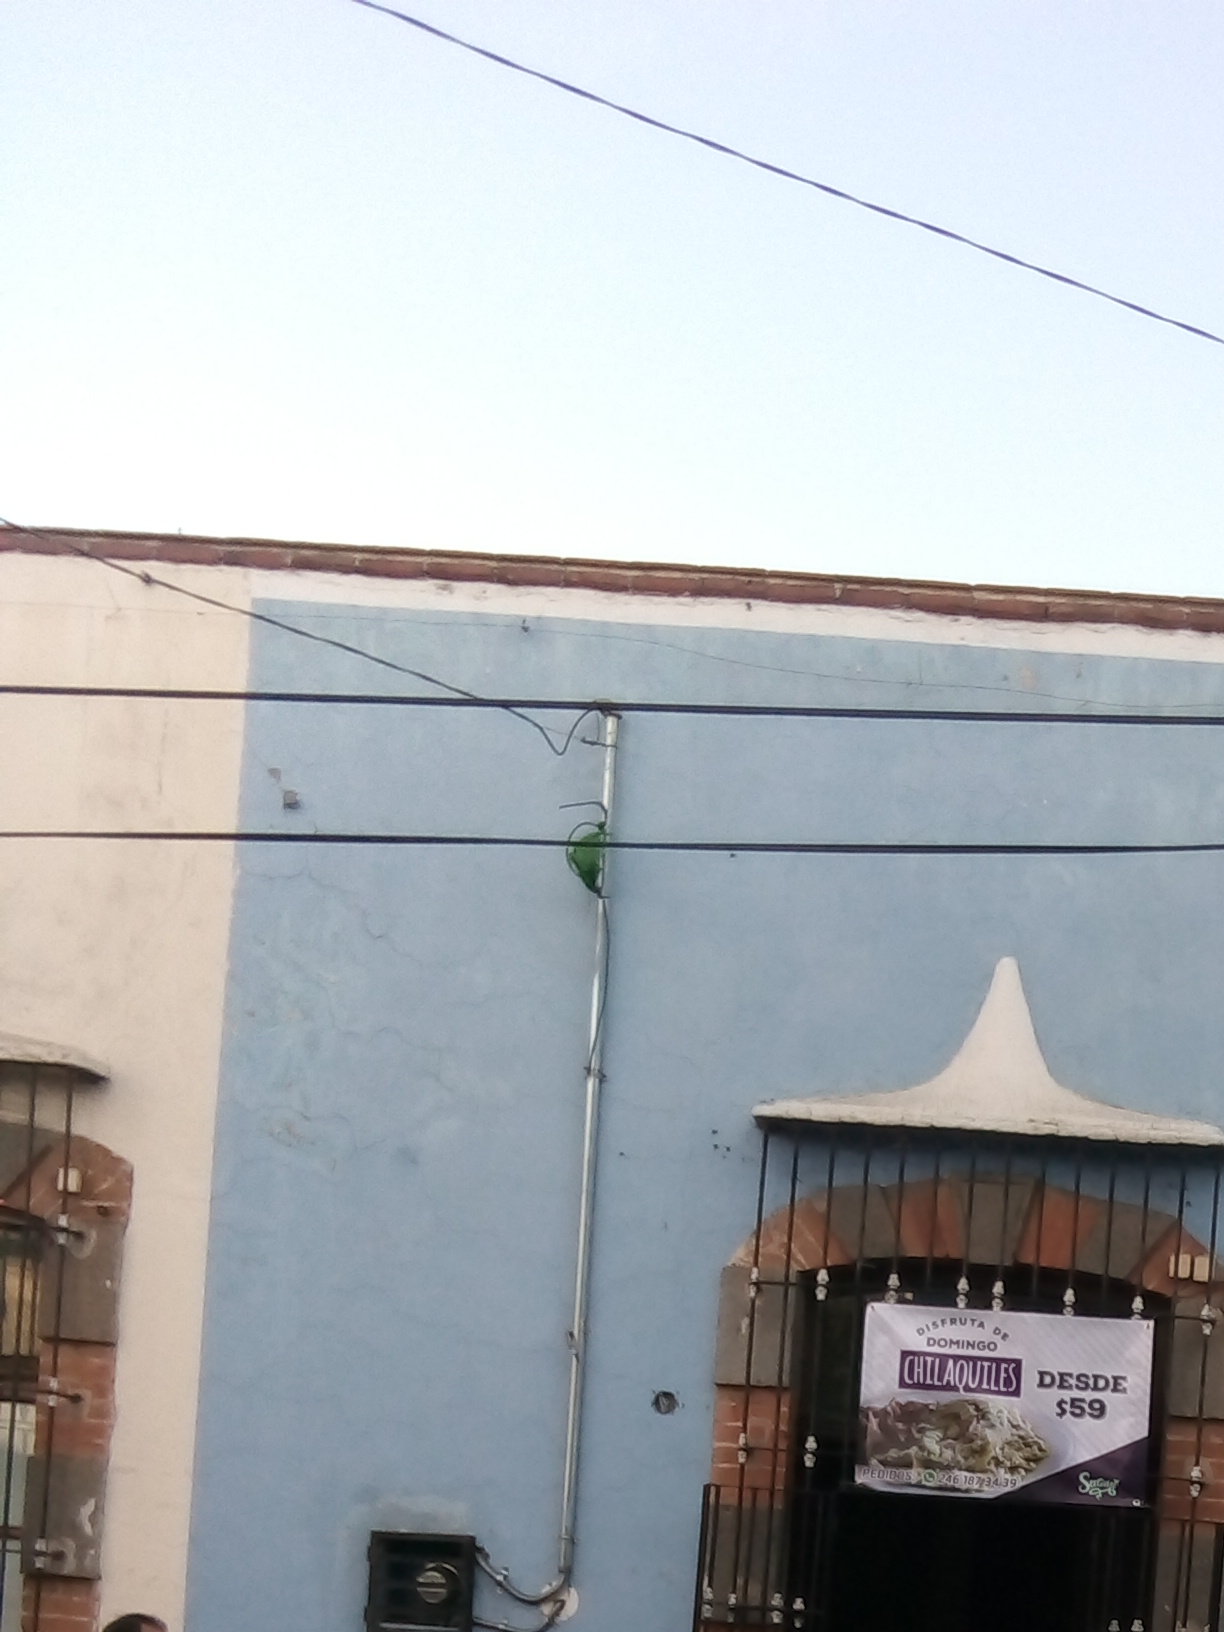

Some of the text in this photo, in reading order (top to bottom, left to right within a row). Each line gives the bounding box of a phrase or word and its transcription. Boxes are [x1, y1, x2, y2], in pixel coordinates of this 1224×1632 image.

[915, 1317, 1010, 1342] DISFRUTA DE
[926, 1337, 998, 1352] DOMINGO
[903, 1355, 1018, 1393] CHILAQUILES
[1036, 1369, 1128, 1394] DESDE
[1055, 1397, 1107, 1420] $59
